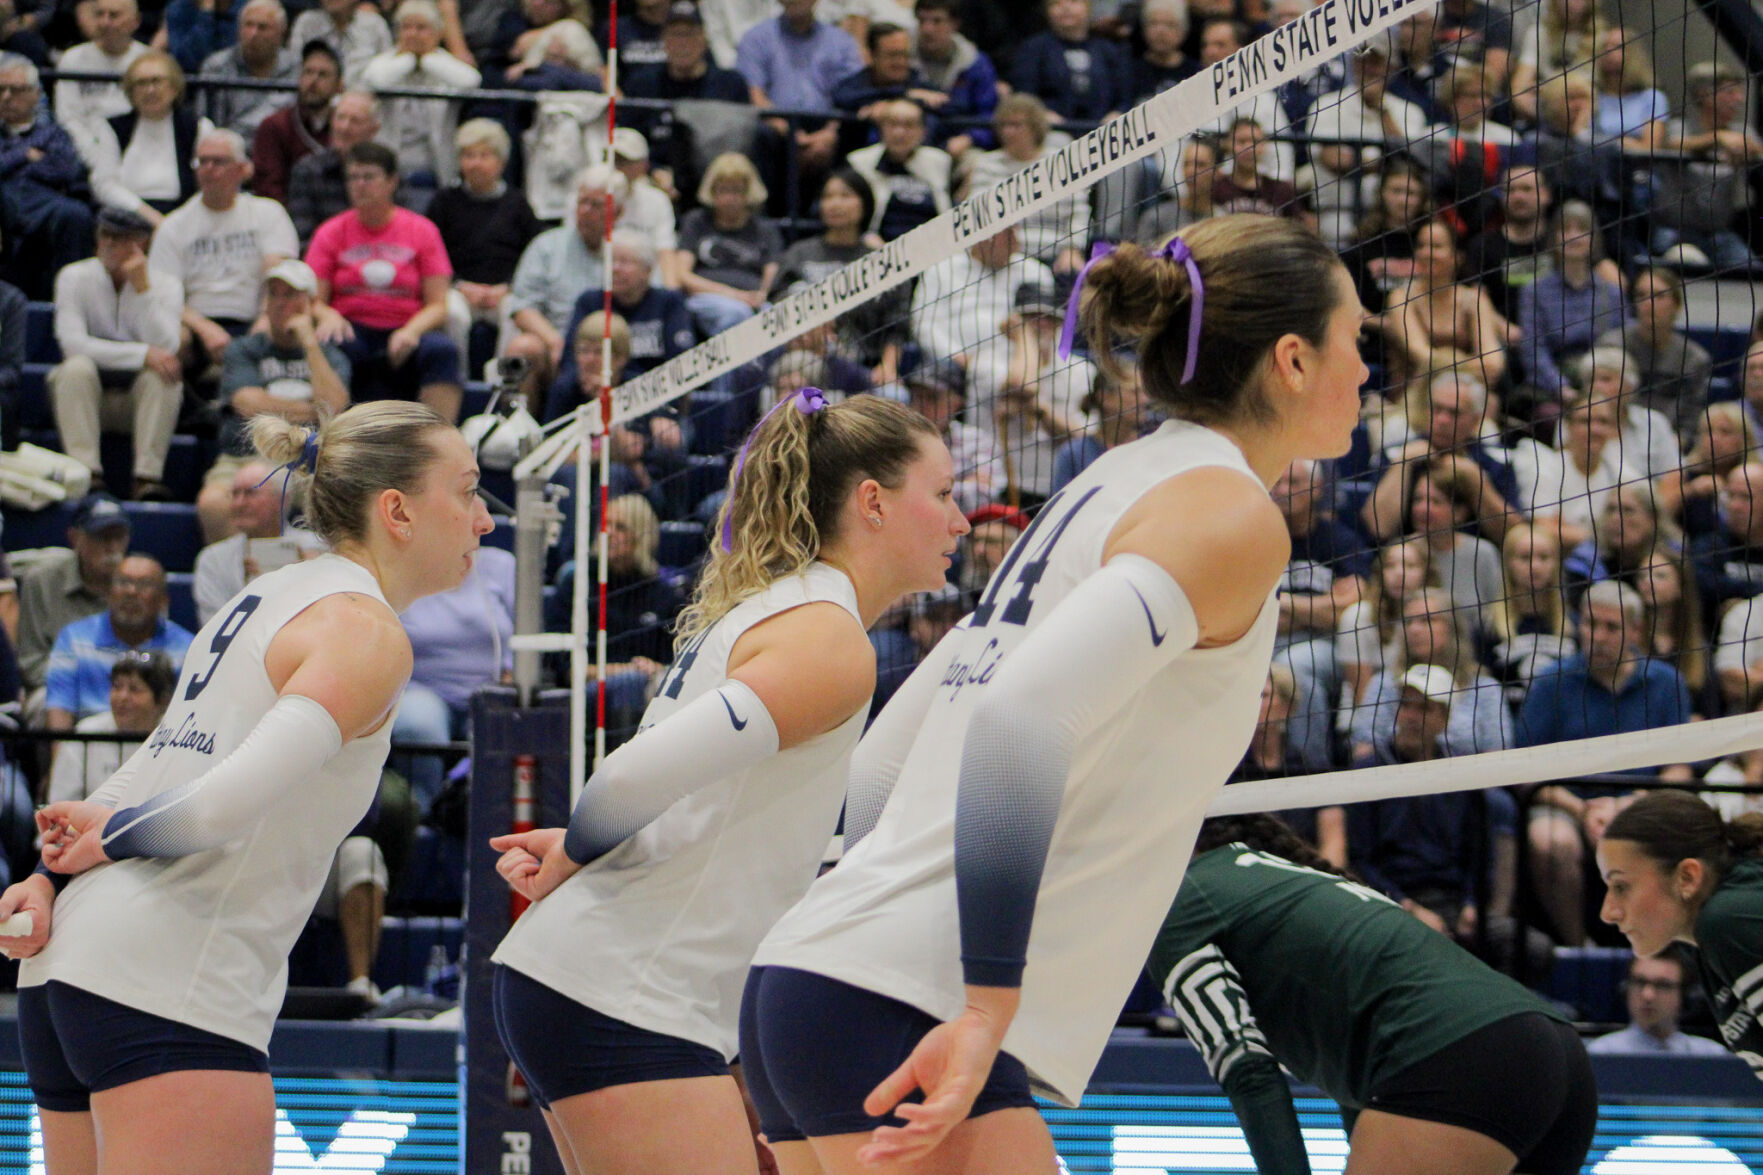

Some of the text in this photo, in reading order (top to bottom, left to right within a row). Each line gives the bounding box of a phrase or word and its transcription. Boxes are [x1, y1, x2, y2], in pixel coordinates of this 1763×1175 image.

[1213, 37, 1268, 105] PENN
[1273, 1, 1337, 72] STATE
[953, 191, 992, 243] PENN
[996, 162, 1042, 219] STATE
[1045, 103, 1156, 193] VOLLEYBALL
[831, 236, 911, 304] VOLLEYBALL
[968, 485, 1104, 627] 14
[184, 594, 263, 701] 9
[170, 711, 217, 755] Lions
